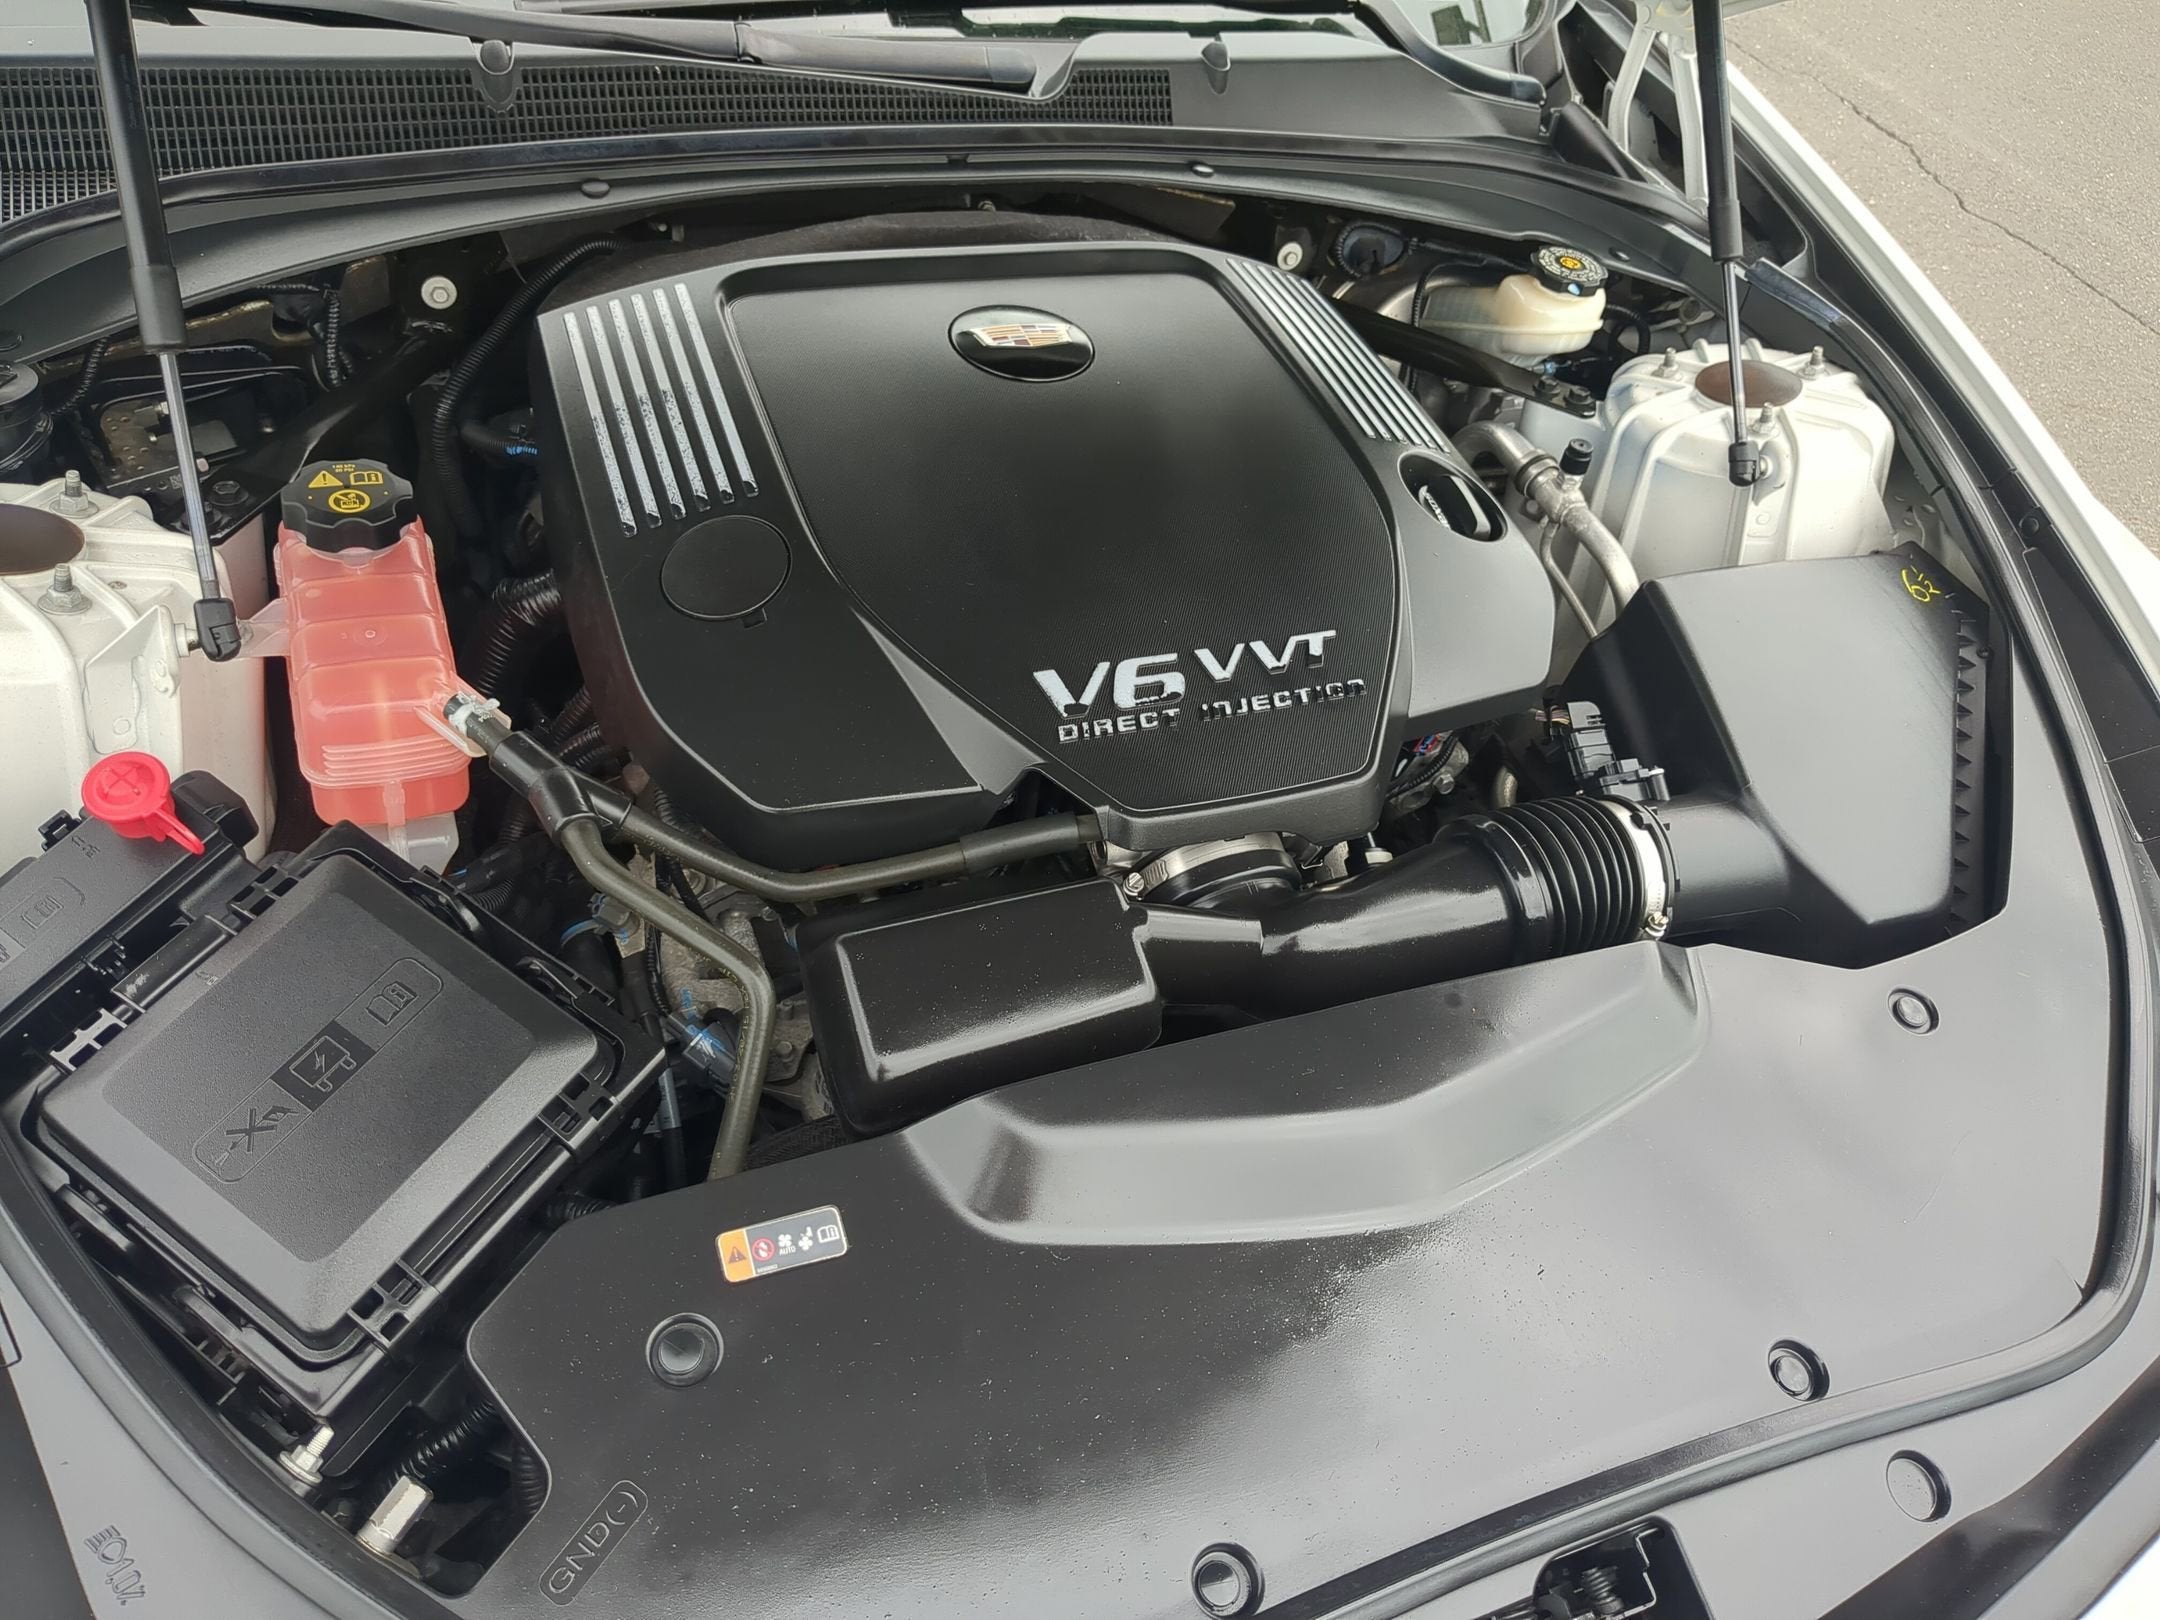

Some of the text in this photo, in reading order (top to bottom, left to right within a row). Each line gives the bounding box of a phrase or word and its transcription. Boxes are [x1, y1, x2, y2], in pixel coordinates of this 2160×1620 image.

[1032, 629, 1337, 719] V6 VVT
[1057, 678, 1367, 744] DIRECT INJECTION
[779, 1246, 796, 1256] AUTO
[549, 1491, 639, 1594] GND(-)
